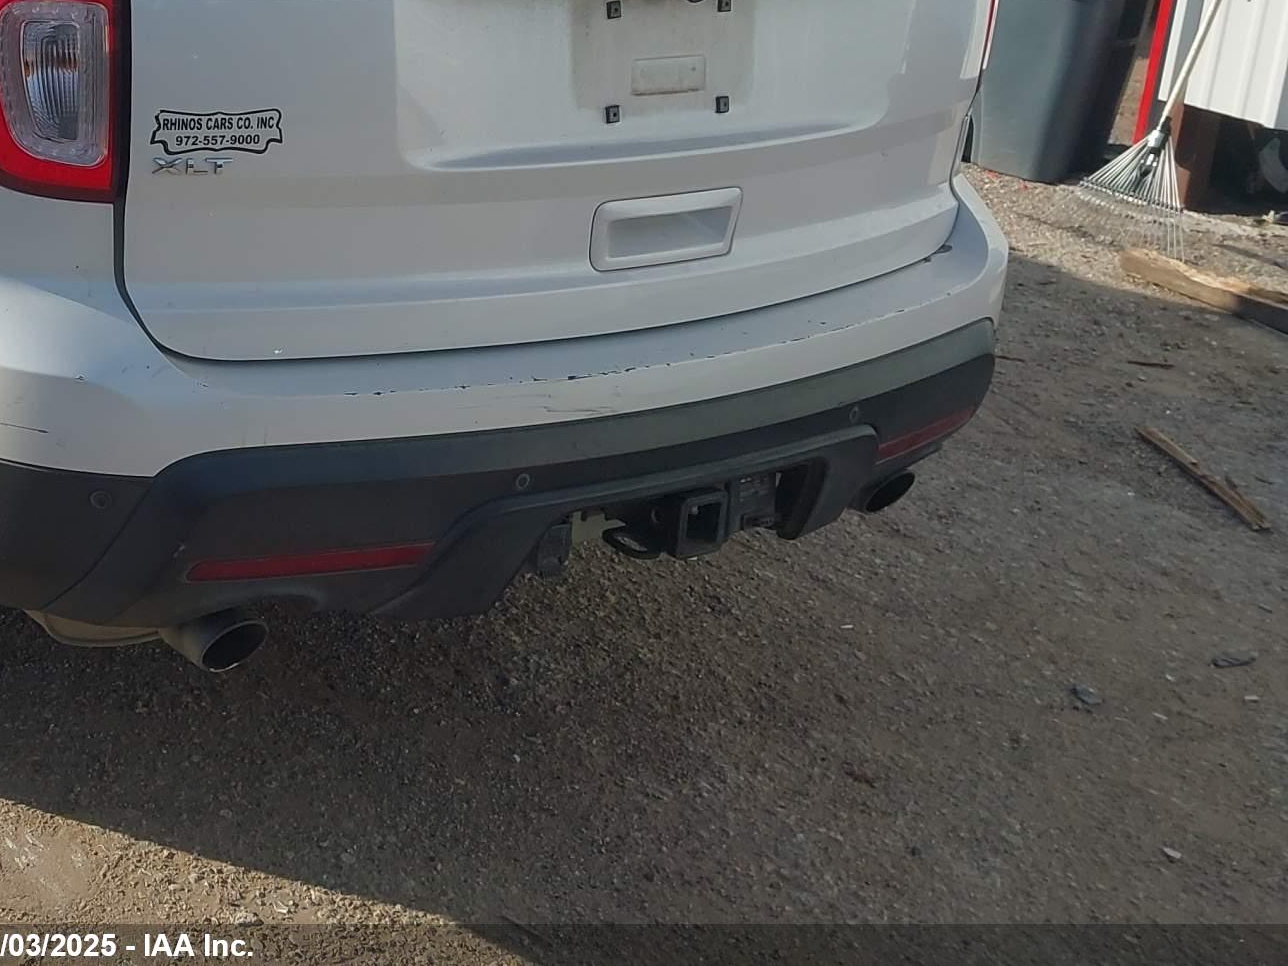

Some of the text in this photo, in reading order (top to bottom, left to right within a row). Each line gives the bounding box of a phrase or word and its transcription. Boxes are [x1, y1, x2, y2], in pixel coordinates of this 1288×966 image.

[162, 116, 275, 131] RHINOS CARS CO. INC
[175, 135, 260, 146] 972-557-9000
[152, 157, 234, 175] XLT
